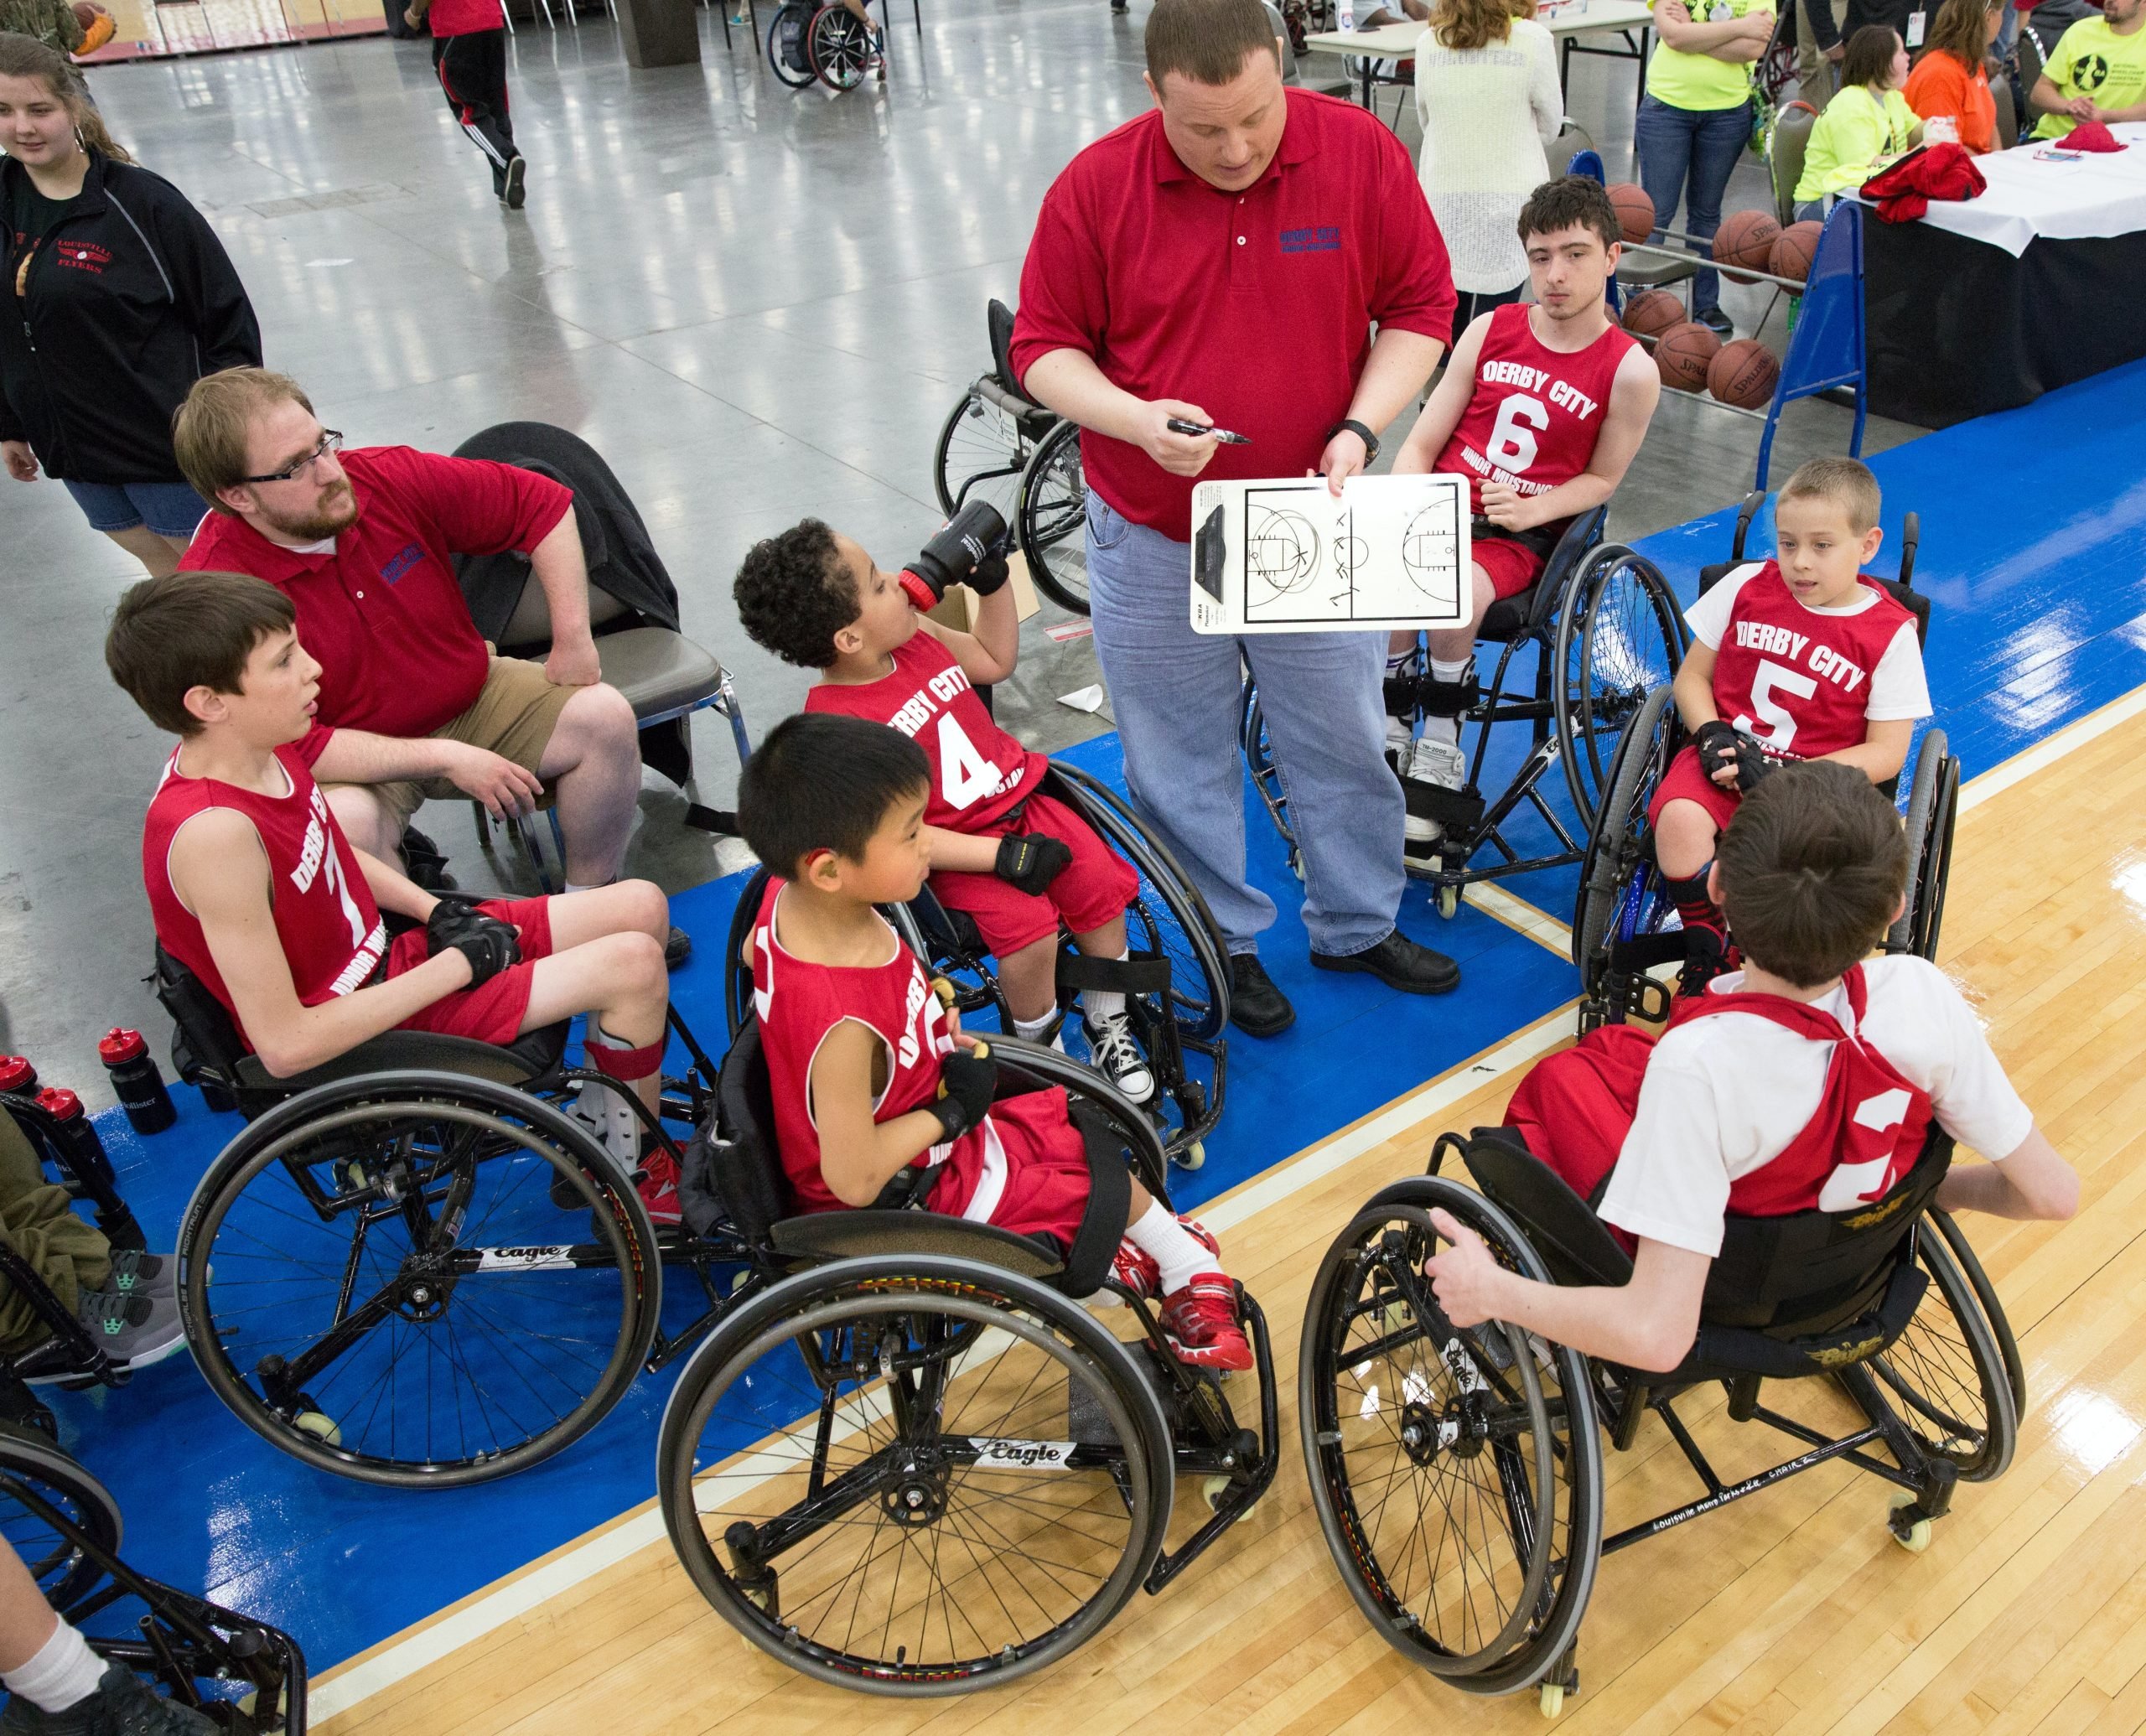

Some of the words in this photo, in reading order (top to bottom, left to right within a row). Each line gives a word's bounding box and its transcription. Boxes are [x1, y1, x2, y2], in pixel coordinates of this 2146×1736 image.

[57, 258, 102, 275] FLYERS
[1483, 360, 1550, 393] DERBY
[1548, 380, 1598, 421] CITY
[1460, 445, 1492, 477] JUNIOR
[1486, 392, 1549, 474] 6
[1736, 620, 1810, 661] DERBY
[1808, 645, 1866, 693] CITY
[1732, 658, 1819, 751] 5
[937, 711, 1004, 811] 4
[324, 827, 366, 950] 7
[180, 1289, 195, 1341] SCHWALBE
[990, 1442, 1061, 1465] Eagle
[1653, 1509, 1695, 1531] Louisville
[1769, 1461, 1801, 1478] CHAIR
